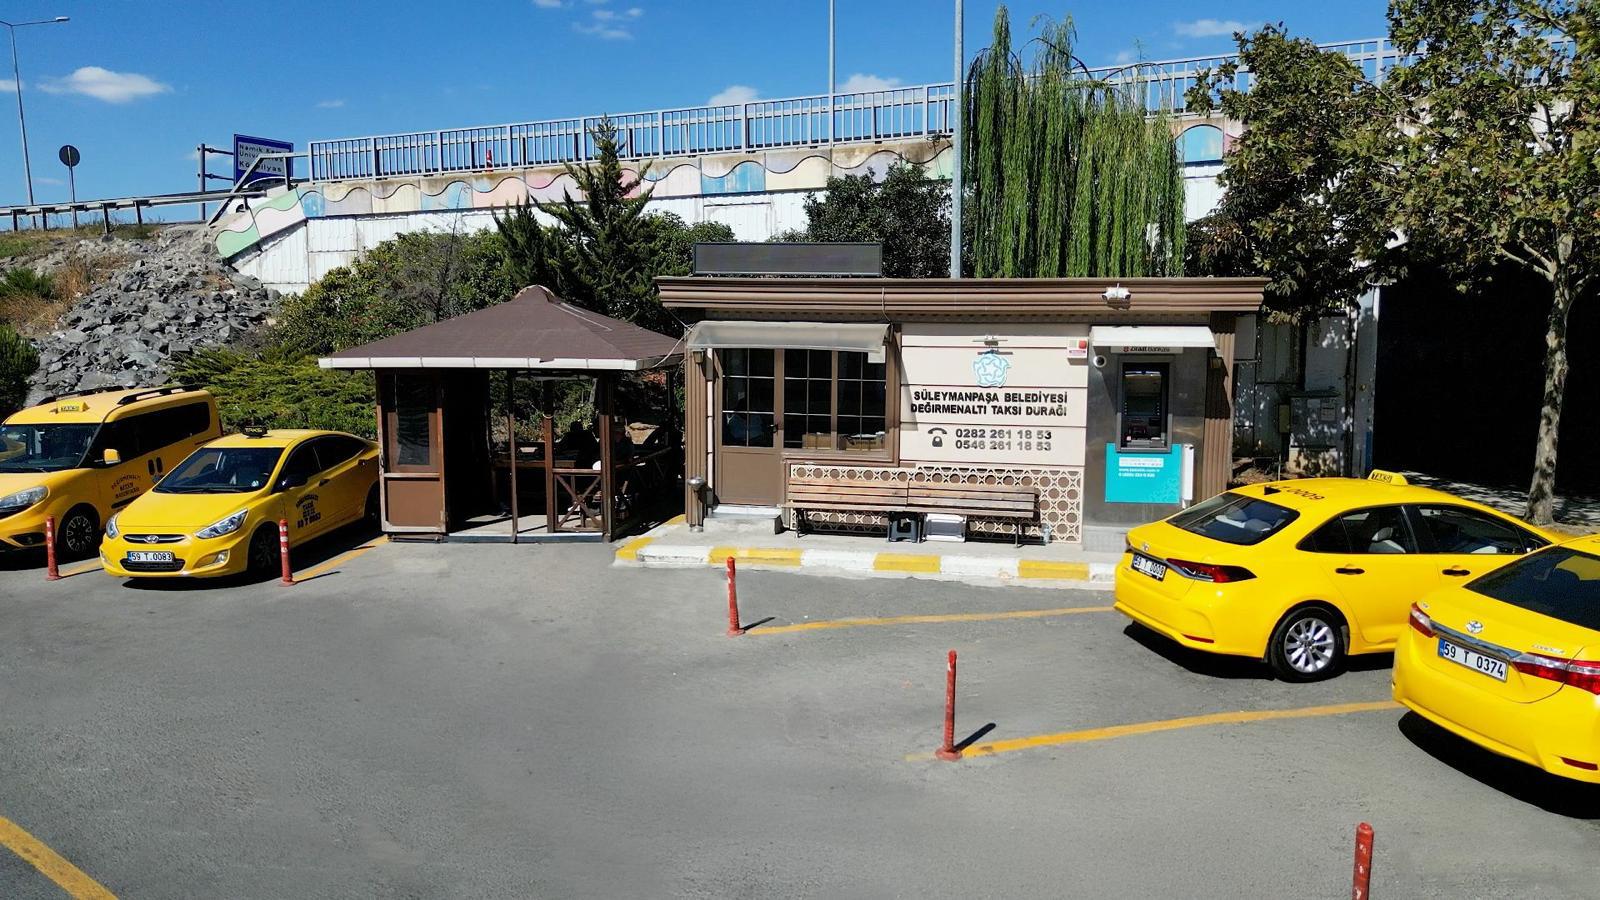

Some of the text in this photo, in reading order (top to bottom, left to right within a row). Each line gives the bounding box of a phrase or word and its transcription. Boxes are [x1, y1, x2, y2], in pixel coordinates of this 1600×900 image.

[914, 388, 1068, 404] SÜLEYMANPAŞA BELEDİYESİ
[1026, 405, 1067, 416] DURAĞI
[955, 428, 1052, 440] 0282 261 18 53
[955, 439, 1052, 451] 0546 261 18 53
[131, 552, 141, 561] 59
[143, 552, 149, 561] T
[1444, 643, 1504, 678] 59 T 0374
